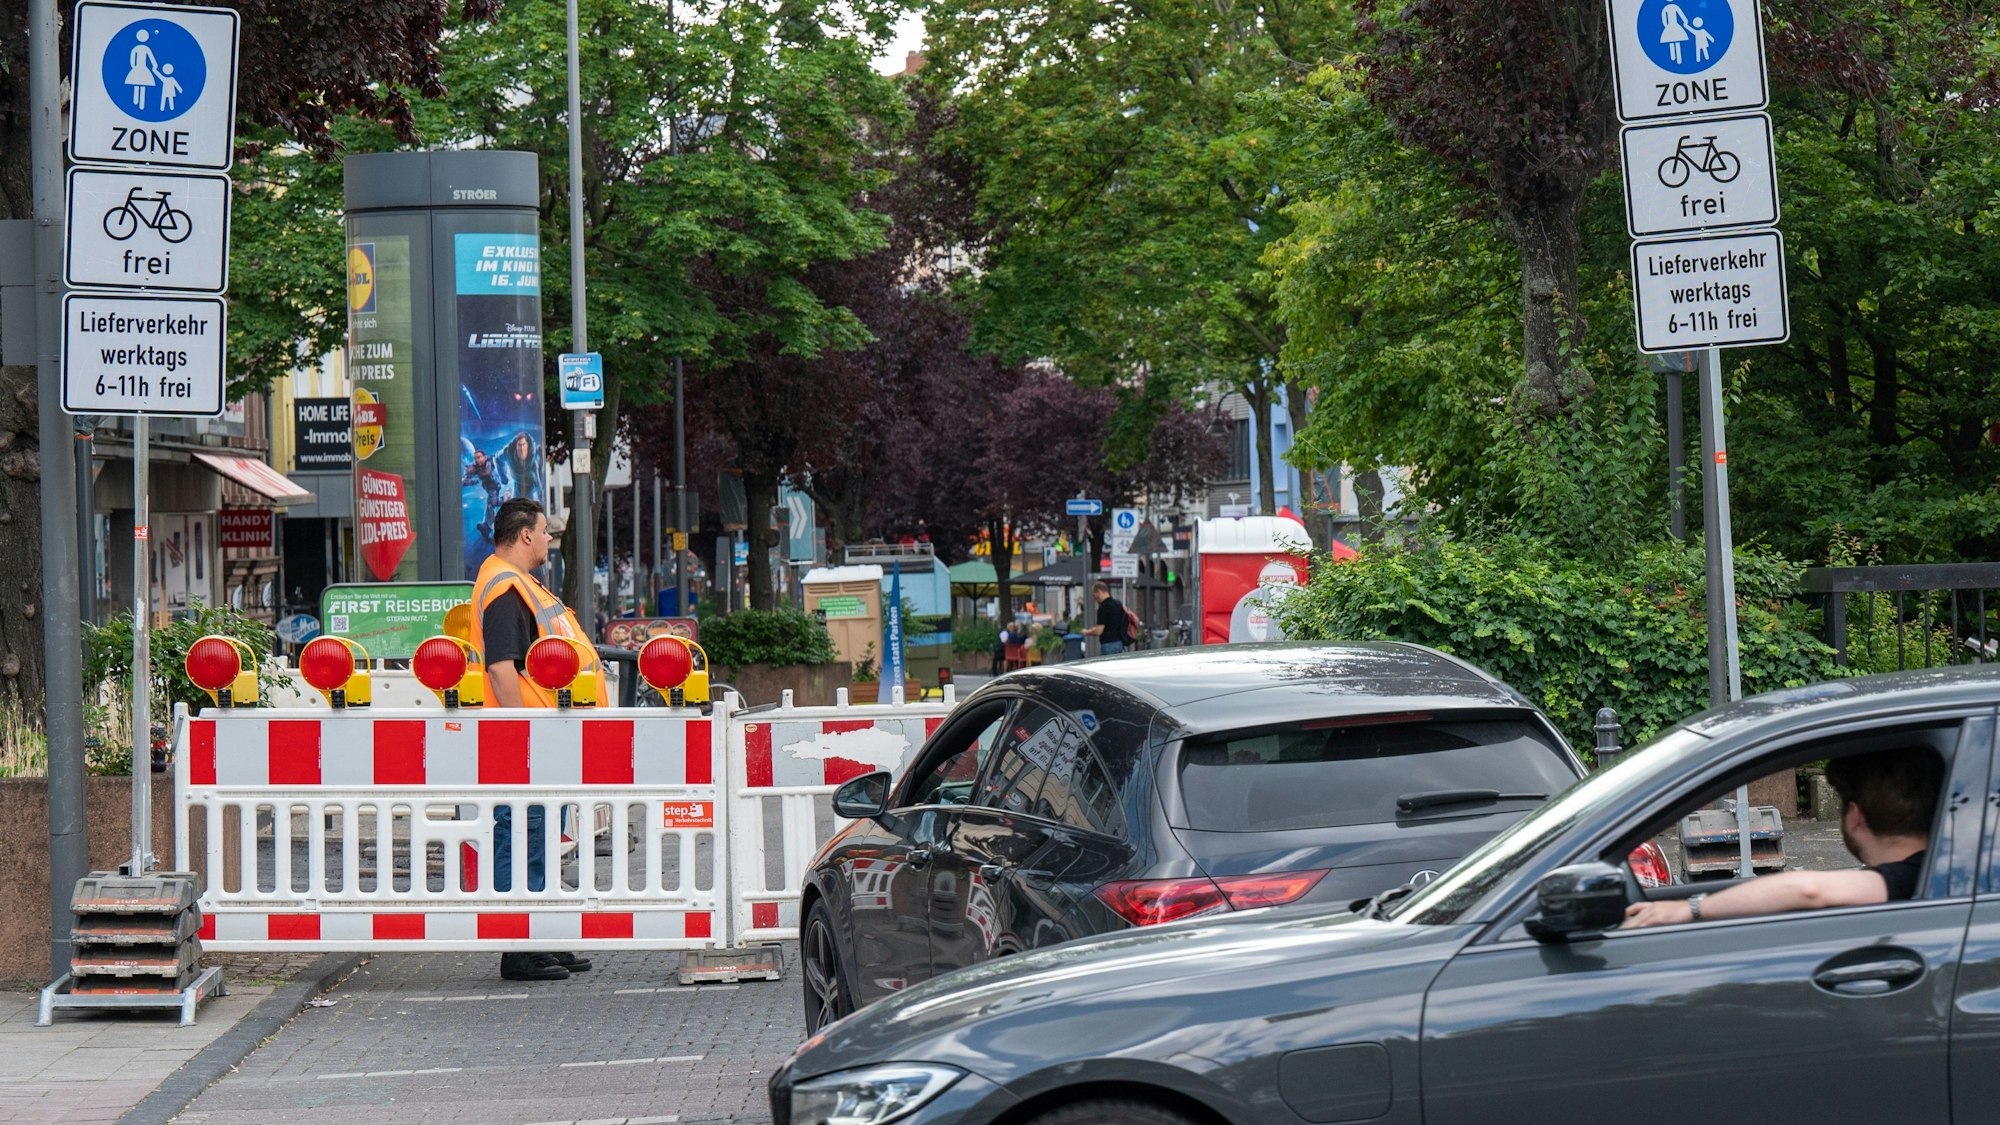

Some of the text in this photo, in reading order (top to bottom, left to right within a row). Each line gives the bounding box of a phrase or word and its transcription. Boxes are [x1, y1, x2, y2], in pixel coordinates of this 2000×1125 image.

[1656, 78, 1728, 106] ZONE
[111, 127, 189, 156] ZONE
[453, 188, 497, 200] STRÖER
[1680, 192, 1726, 217] frei
[123, 250, 171, 275] frei
[476, 260, 498, 272] IM
[502, 261, 533, 272] KINO
[1648, 249, 1767, 276] Lieferverkehr
[491, 274, 513, 287] 16.
[1670, 281, 1751, 304] werktags
[80, 311, 208, 336] Lieferverkehr
[364, 317, 377, 328] sich
[1668, 308, 1757, 334] 6-11h frei
[101, 344, 187, 372] werktags
[367, 343, 393, 359] ZUM
[361, 364, 395, 380] PREIS
[95, 375, 191, 398] 6-11h frei
[299, 405, 349, 422] HOME LIFE
[362, 473, 397, 497] GÜNSTIG
[360, 495, 406, 518] GÜNSTIGER
[221, 514, 271, 527] HANDY
[222, 530, 271, 542] KLINIK
[361, 521, 408, 545] LIDL-PREIS
[327, 601, 381, 613] FIRST
[889, 606, 899, 641] Parken
[891, 641, 900, 665] statt
[665, 805, 689, 818] step
